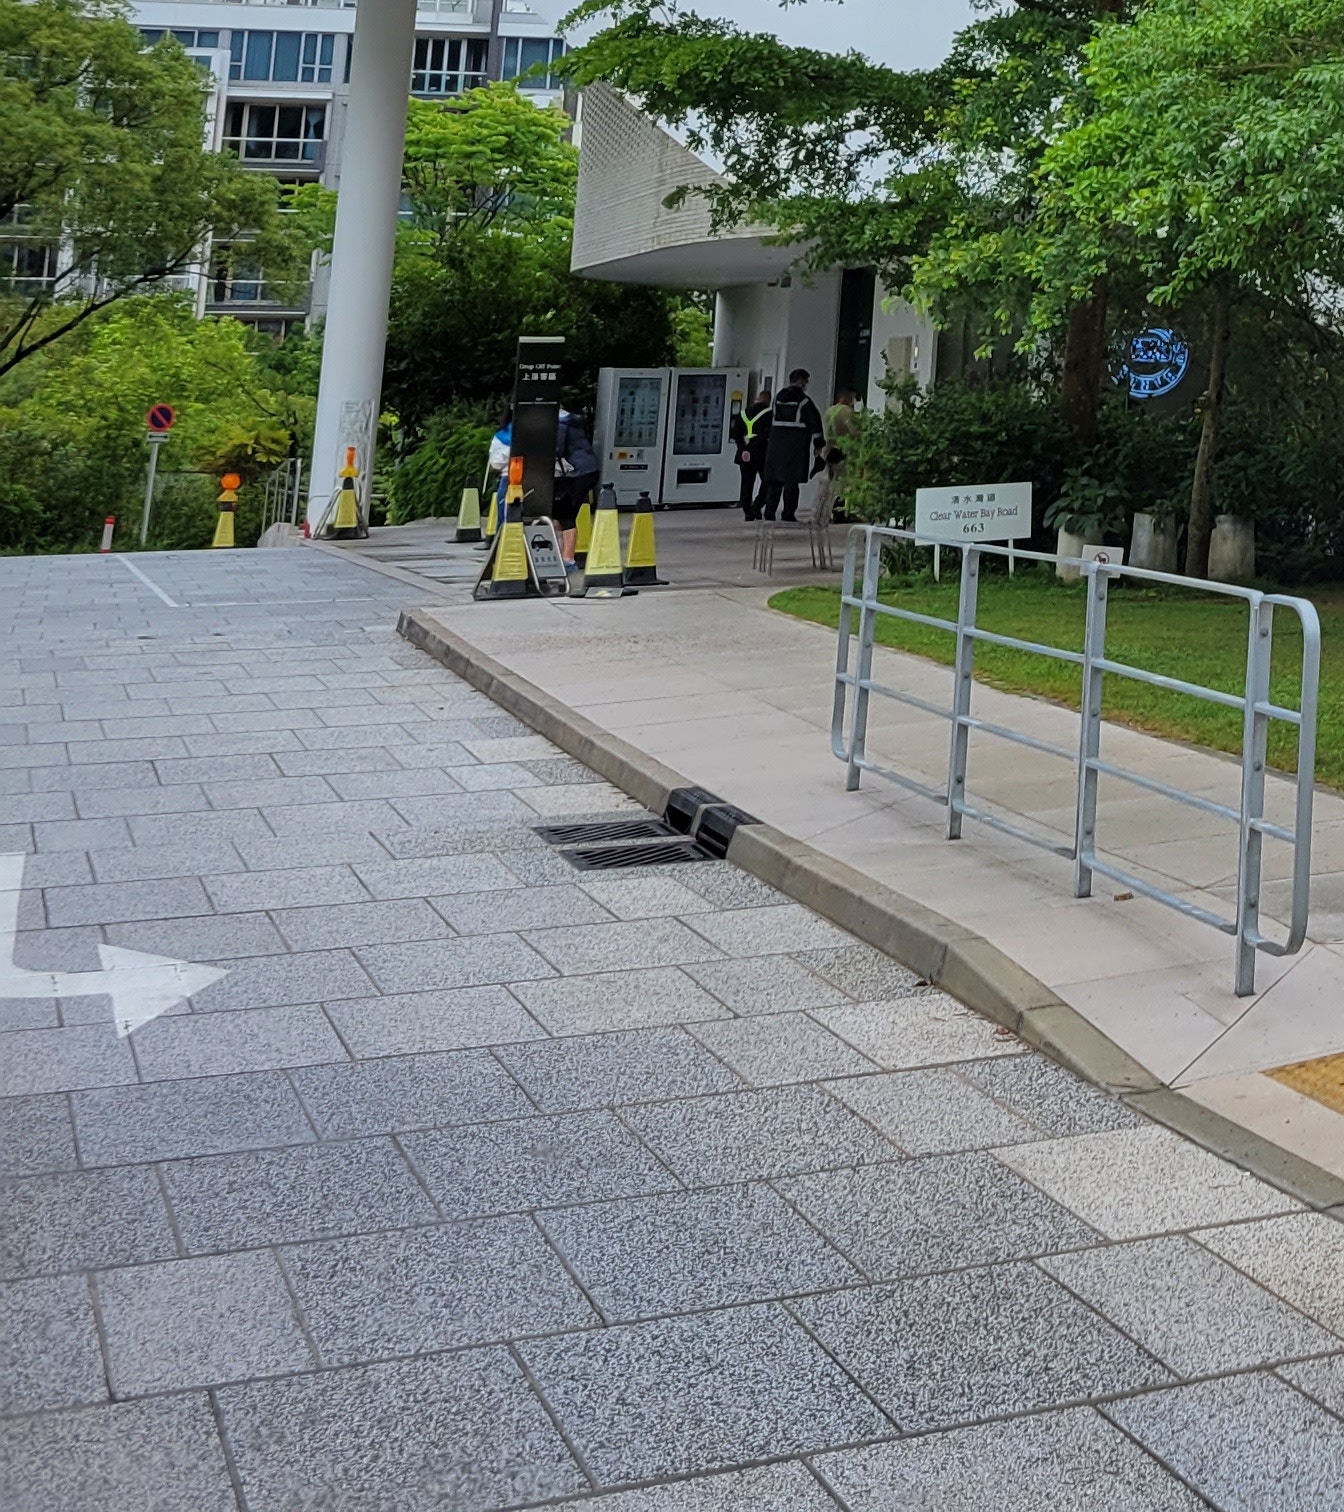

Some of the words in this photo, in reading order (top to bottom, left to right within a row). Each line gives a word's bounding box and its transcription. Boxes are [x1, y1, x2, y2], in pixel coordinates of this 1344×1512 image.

[930, 511, 952, 521] Clear
[954, 509, 979, 519] Water
[981, 509, 995, 519] Bay
[997, 506, 1018, 517] Road
[963, 523, 984, 533] 663
